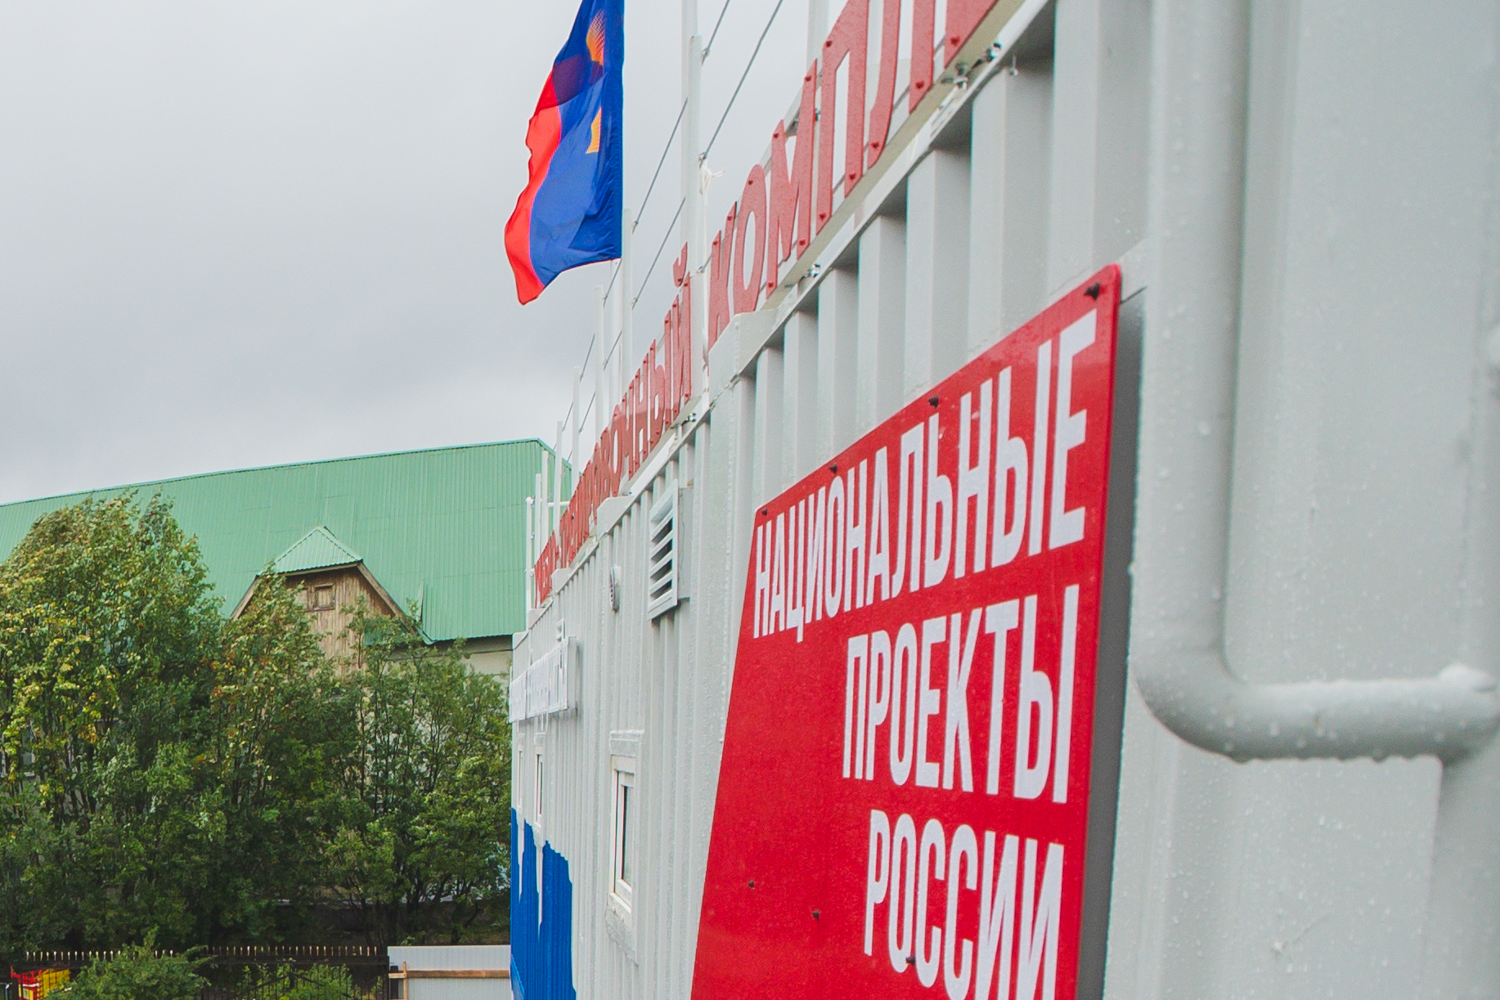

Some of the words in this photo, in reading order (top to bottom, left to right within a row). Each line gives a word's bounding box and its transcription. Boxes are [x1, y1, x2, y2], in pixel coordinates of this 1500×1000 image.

[708, 0, 998, 350] КОМПЛ
[752, 309, 1098, 643] НАЦИОНАЛЬНЫЕ
[842, 585, 1079, 804] ПРОЕКТЫ
